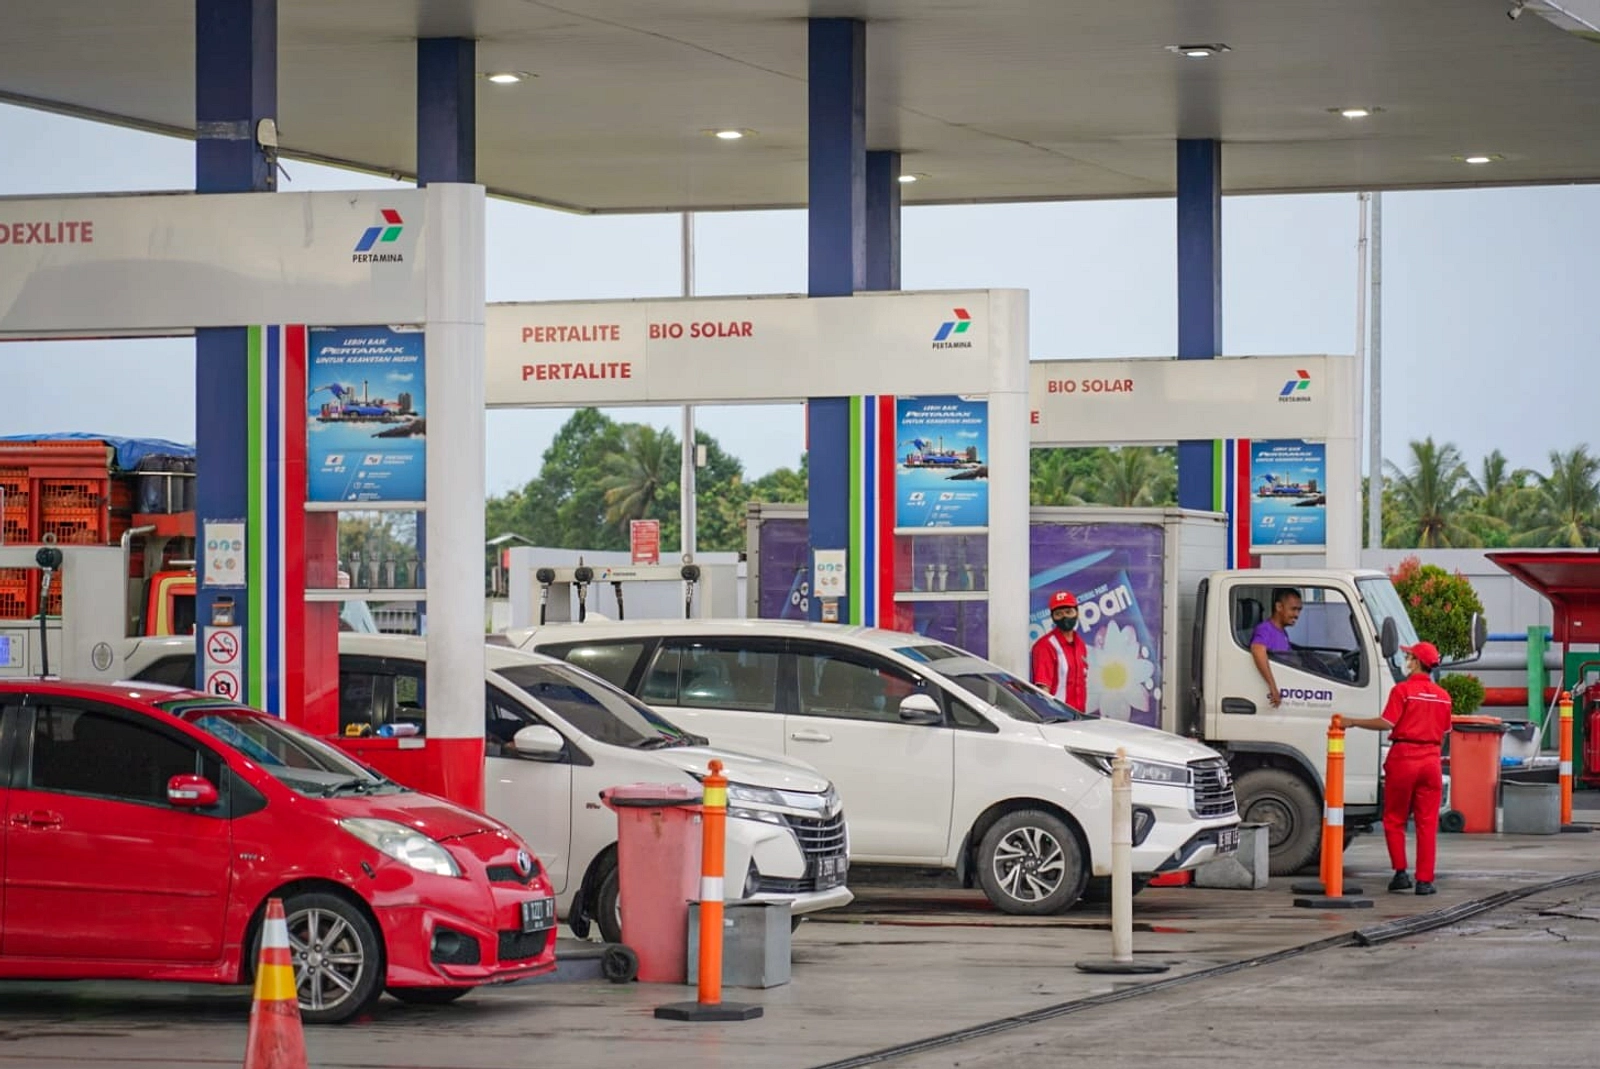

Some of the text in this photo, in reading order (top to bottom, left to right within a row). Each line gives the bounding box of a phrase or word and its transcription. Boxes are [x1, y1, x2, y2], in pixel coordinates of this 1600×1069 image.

[0, 222, 93, 244] DEXLITE
[352, 253, 404, 263] PERTAMINA
[522, 325, 620, 343] PERTALITE
[649, 321, 753, 339] BIO SOLAR
[320, 346, 405, 355] PERTAMAX
[932, 342, 972, 350] PERTAMINA
[522, 363, 631, 381] PERTALITE
[1048, 379, 1134, 393] BIO SOLAR
[1280, 688, 1333, 701] propan
